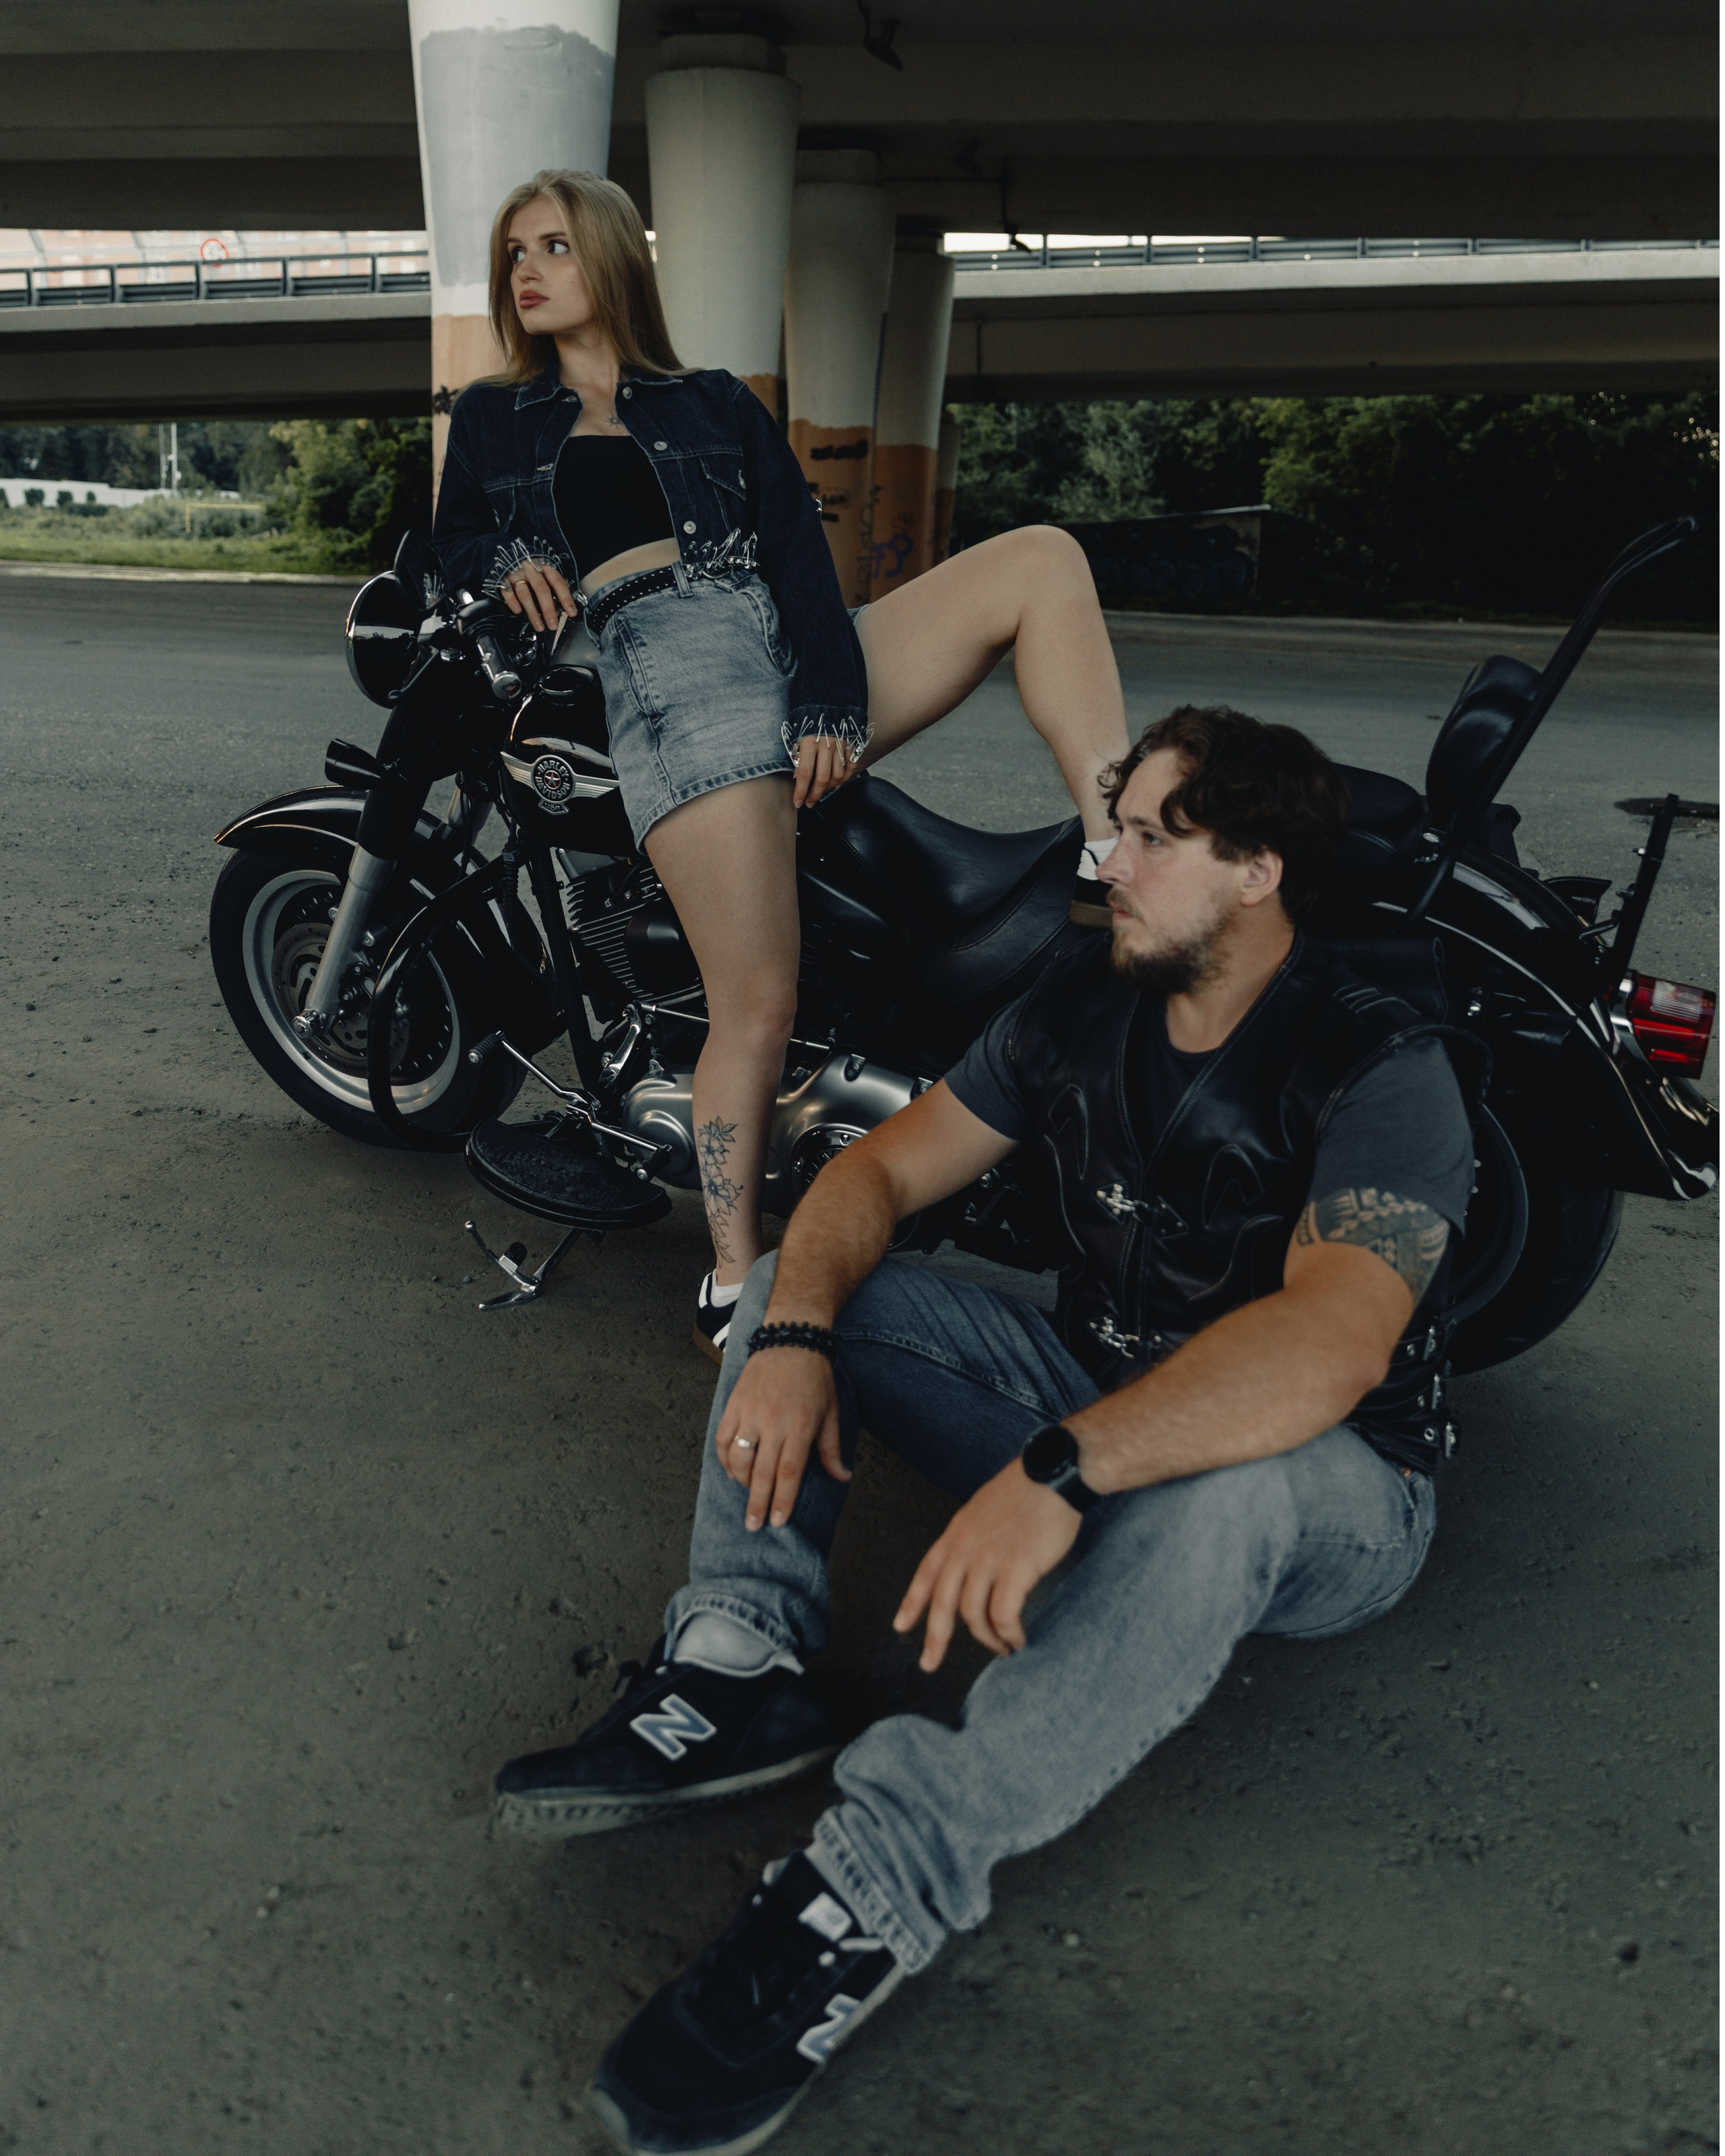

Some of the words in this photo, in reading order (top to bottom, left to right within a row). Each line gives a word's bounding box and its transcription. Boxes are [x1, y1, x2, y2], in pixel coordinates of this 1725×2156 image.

[538, 760, 569, 777] HARLEY
[535, 776, 571, 799] DAVIDSON
[544, 802, 561, 811] USA
[629, 1693, 717, 1762] N
